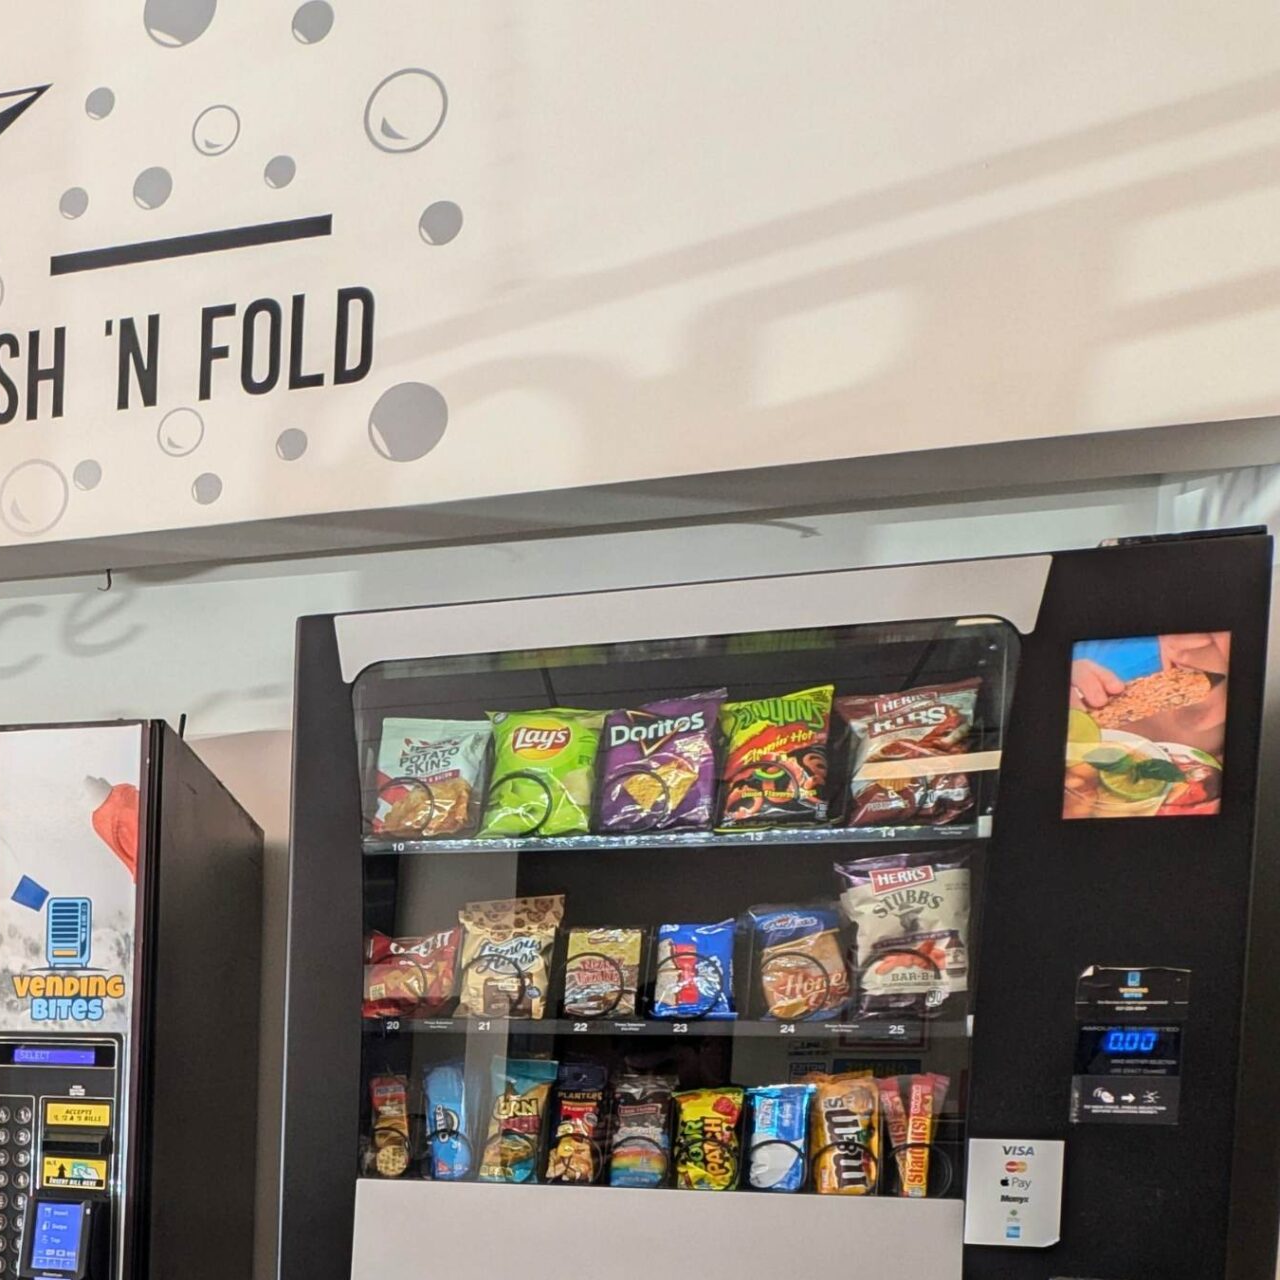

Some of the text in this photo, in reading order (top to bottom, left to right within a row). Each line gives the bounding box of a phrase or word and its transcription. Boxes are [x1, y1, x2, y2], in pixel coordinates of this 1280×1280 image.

[105, 313, 160, 410] 'N
[199, 286, 376, 401] FOLD
[611, 711, 704, 746] Doritos
[514, 726, 571, 749] Lay's
[791, 730, 813, 742] Hot
[400, 747, 459, 767] POTATO
[405, 757, 451, 775] SKINS
[392, 843, 405, 851] 10
[872, 890, 944, 919] STUBB'S
[892, 972, 940, 981] BAR-B-
[387, 1021, 399, 1029] 20
[478, 1021, 491, 1031] 21
[573, 1022, 588, 1032] 22
[673, 1024, 688, 1032] 23
[780, 1024, 795, 1033] 24
[889, 1025, 905, 1034] 25
[557, 1091, 603, 1100] PLANTERS
[1002, 1146, 1034, 1155] VISA
[1012, 1177, 1032, 1190] Pay
